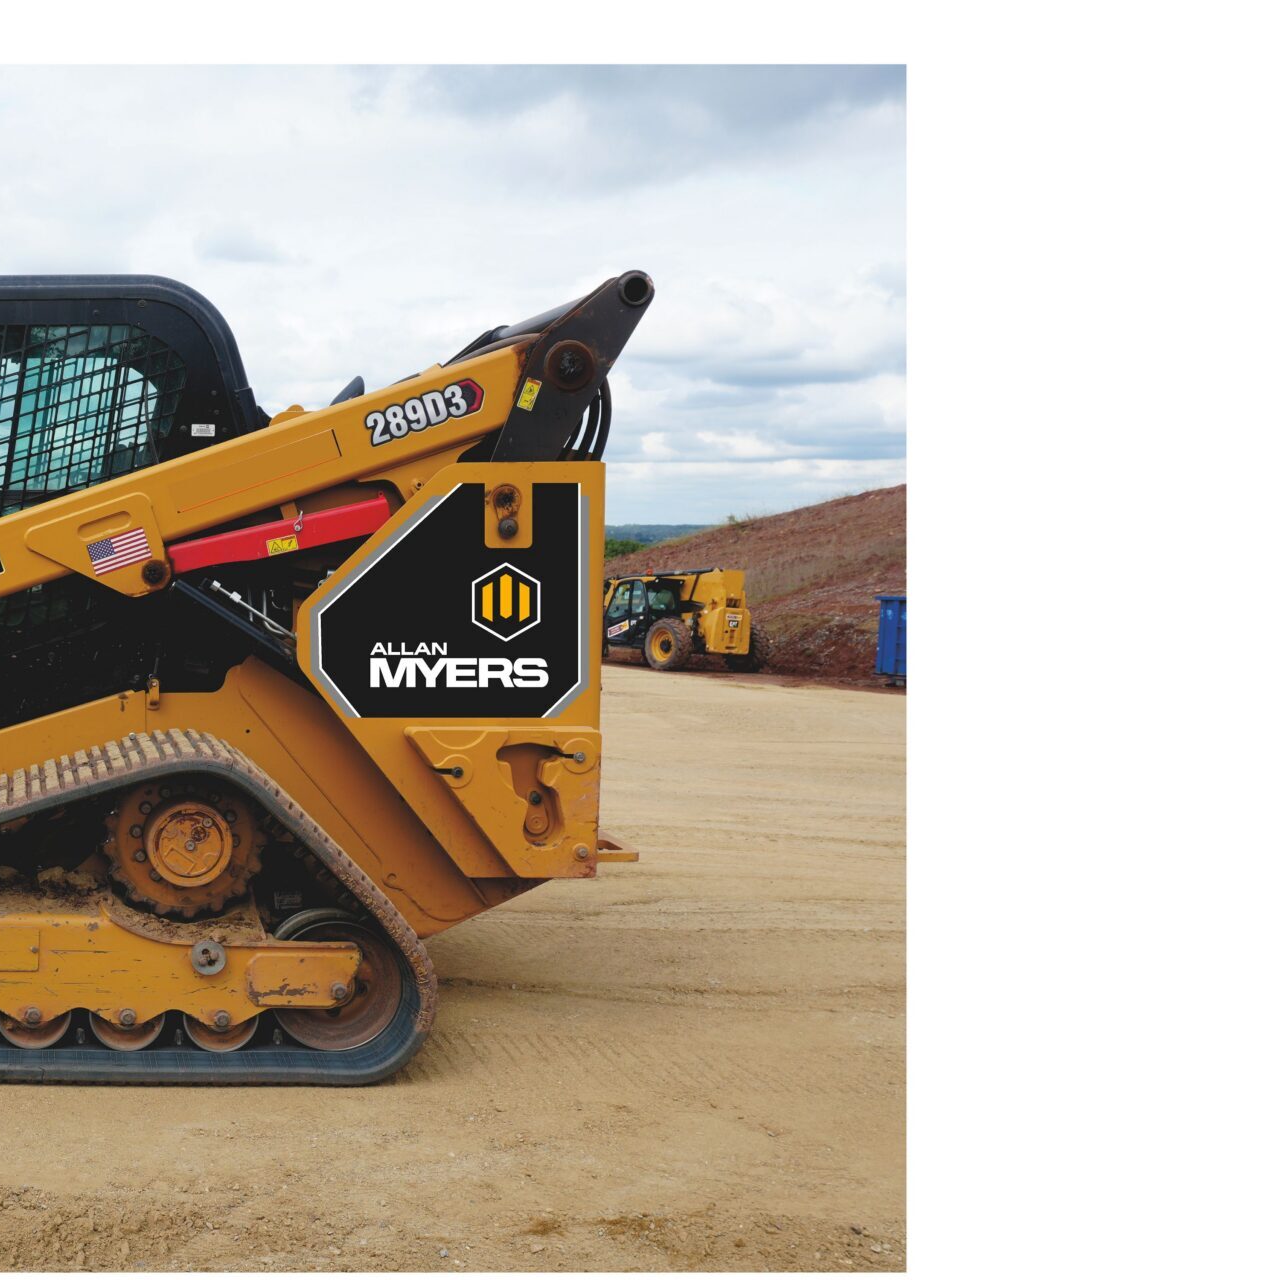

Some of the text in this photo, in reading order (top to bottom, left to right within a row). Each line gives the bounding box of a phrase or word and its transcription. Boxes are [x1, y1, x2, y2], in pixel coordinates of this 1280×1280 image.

[365, 384, 468, 446] 289D3
[370, 642, 447, 656] ALLAN
[370, 657, 549, 688] MYERS
